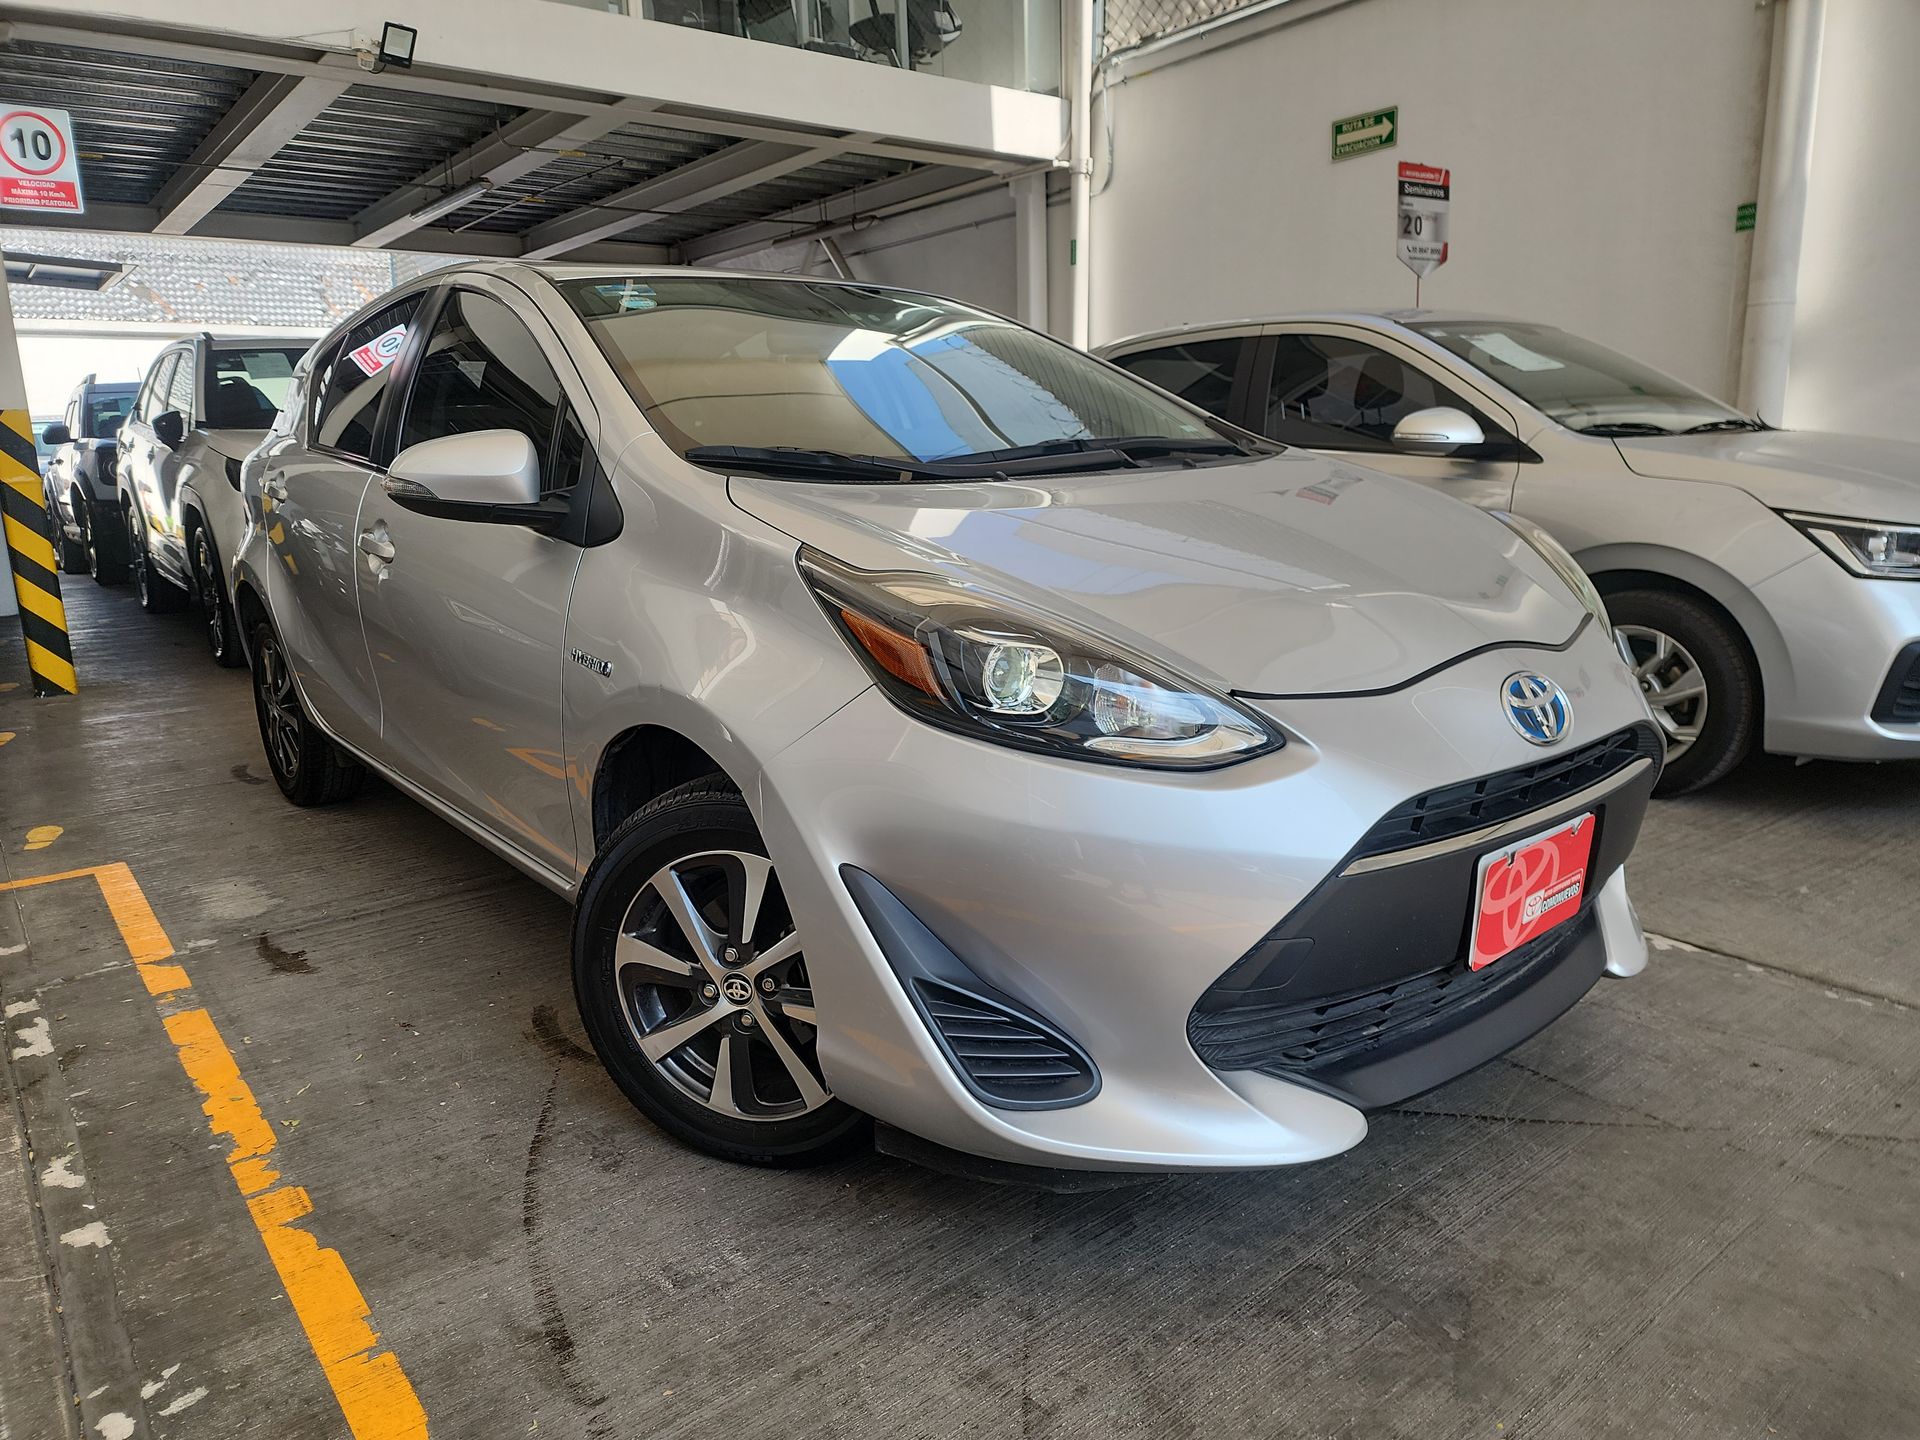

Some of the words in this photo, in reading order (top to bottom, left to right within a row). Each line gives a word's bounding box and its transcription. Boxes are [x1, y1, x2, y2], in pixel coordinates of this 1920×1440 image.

[1342, 119, 1363, 132] RUTA
[1364, 115, 1375, 128] DE
[10, 127, 52, 161] 10
[18, 179, 55, 188] VELOCIDAD
[1404, 183, 1445, 198] Seminuevos
[3, 197, 40, 205] PRIORIDAD
[41, 199, 76, 208] PEATONAL
[1403, 214, 1423, 236] 20
